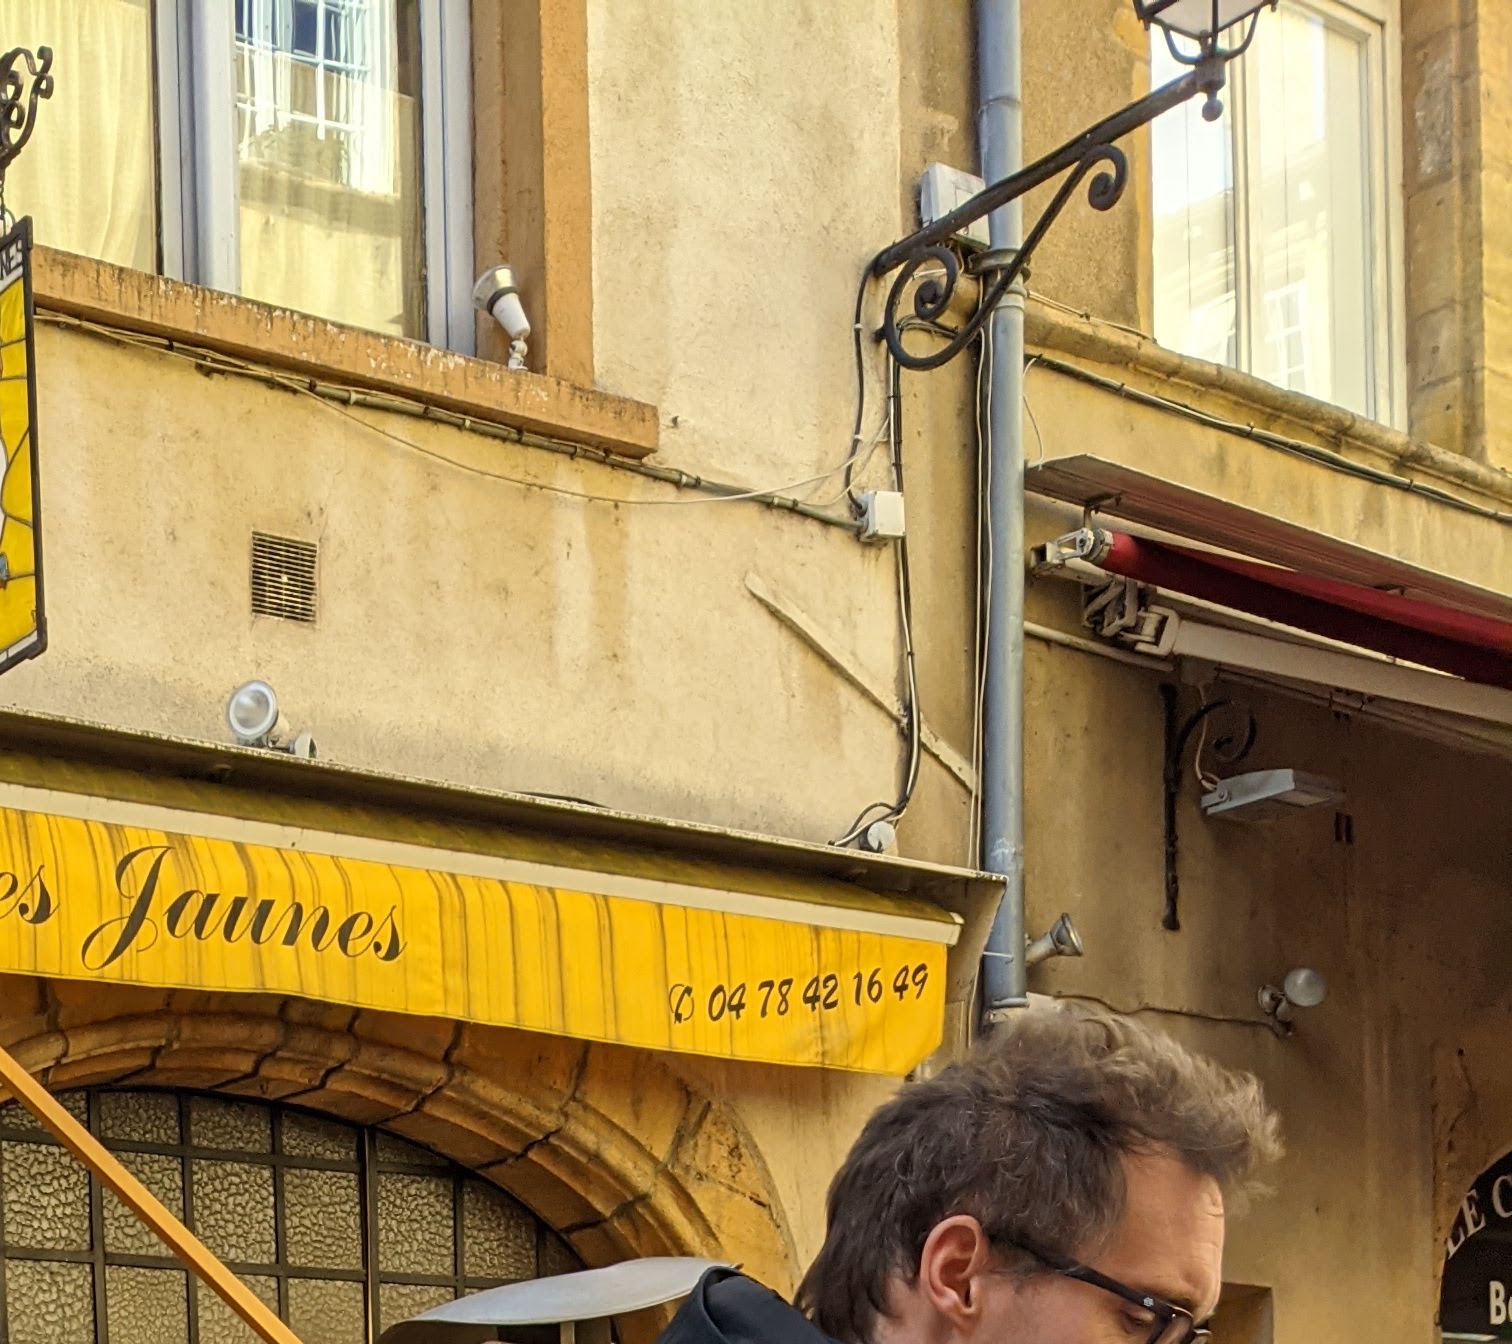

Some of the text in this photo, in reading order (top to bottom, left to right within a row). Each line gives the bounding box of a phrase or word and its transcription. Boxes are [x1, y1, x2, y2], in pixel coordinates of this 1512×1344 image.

[82, 844, 408, 972] Jaunes
[707, 963, 929, 1022] 04 78 42 16 49
